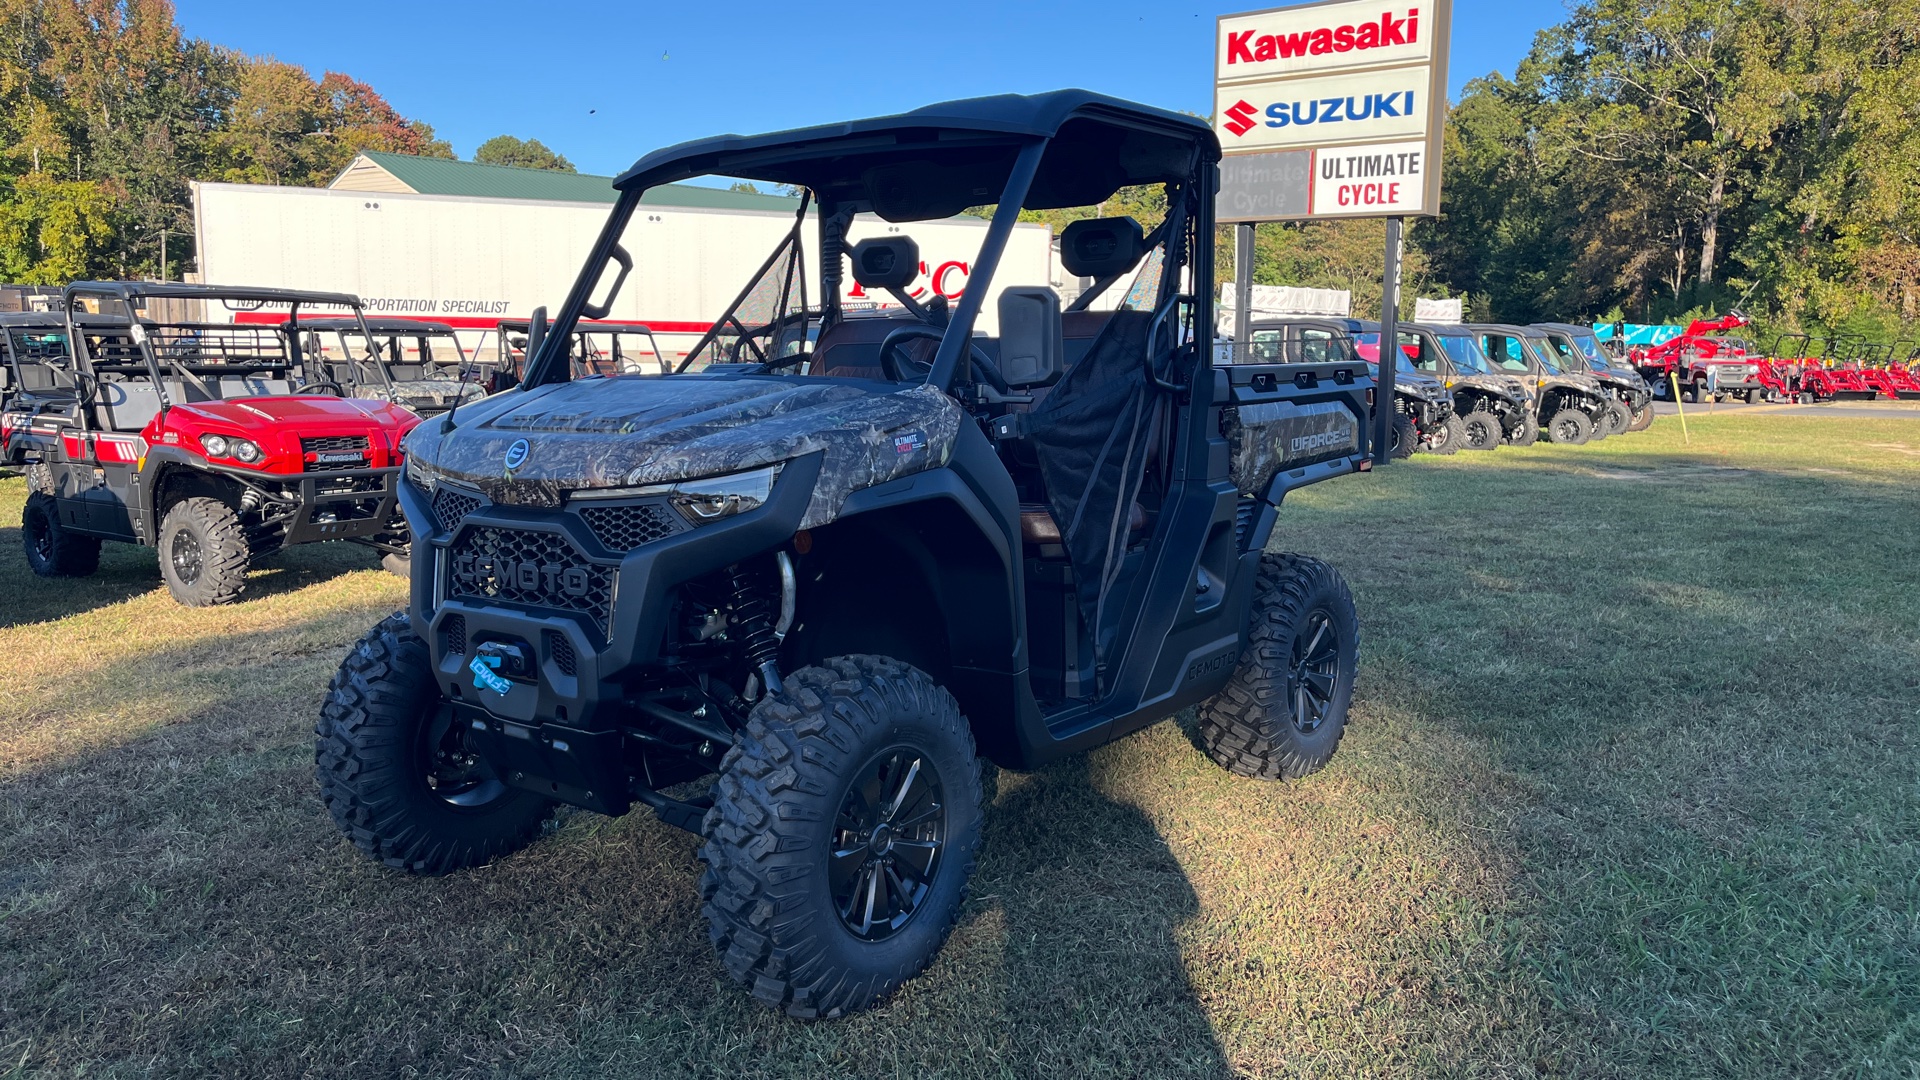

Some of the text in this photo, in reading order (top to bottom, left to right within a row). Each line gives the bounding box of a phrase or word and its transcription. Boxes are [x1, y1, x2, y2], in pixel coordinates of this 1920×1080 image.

[1227, 8, 1419, 64] Kawasaki
[1264, 90, 1414, 128] SUZUKI
[1321, 152, 1420, 180] ULTIMATE
[1233, 188, 1287, 213] Cycle
[1338, 182, 1400, 207] CYCLE
[1394, 221, 1403, 307] 1820
[441, 300, 510, 314] SPECIALIST
[894, 433, 918, 447] ULTIMATE
[897, 443, 912, 453] CYCLE
[1291, 431, 1340, 452] UFORCE
[318, 452, 364, 463] Kawasaki
[458, 554, 589, 597] CFMOTO
[1188, 650, 1236, 681] CFMOTO
